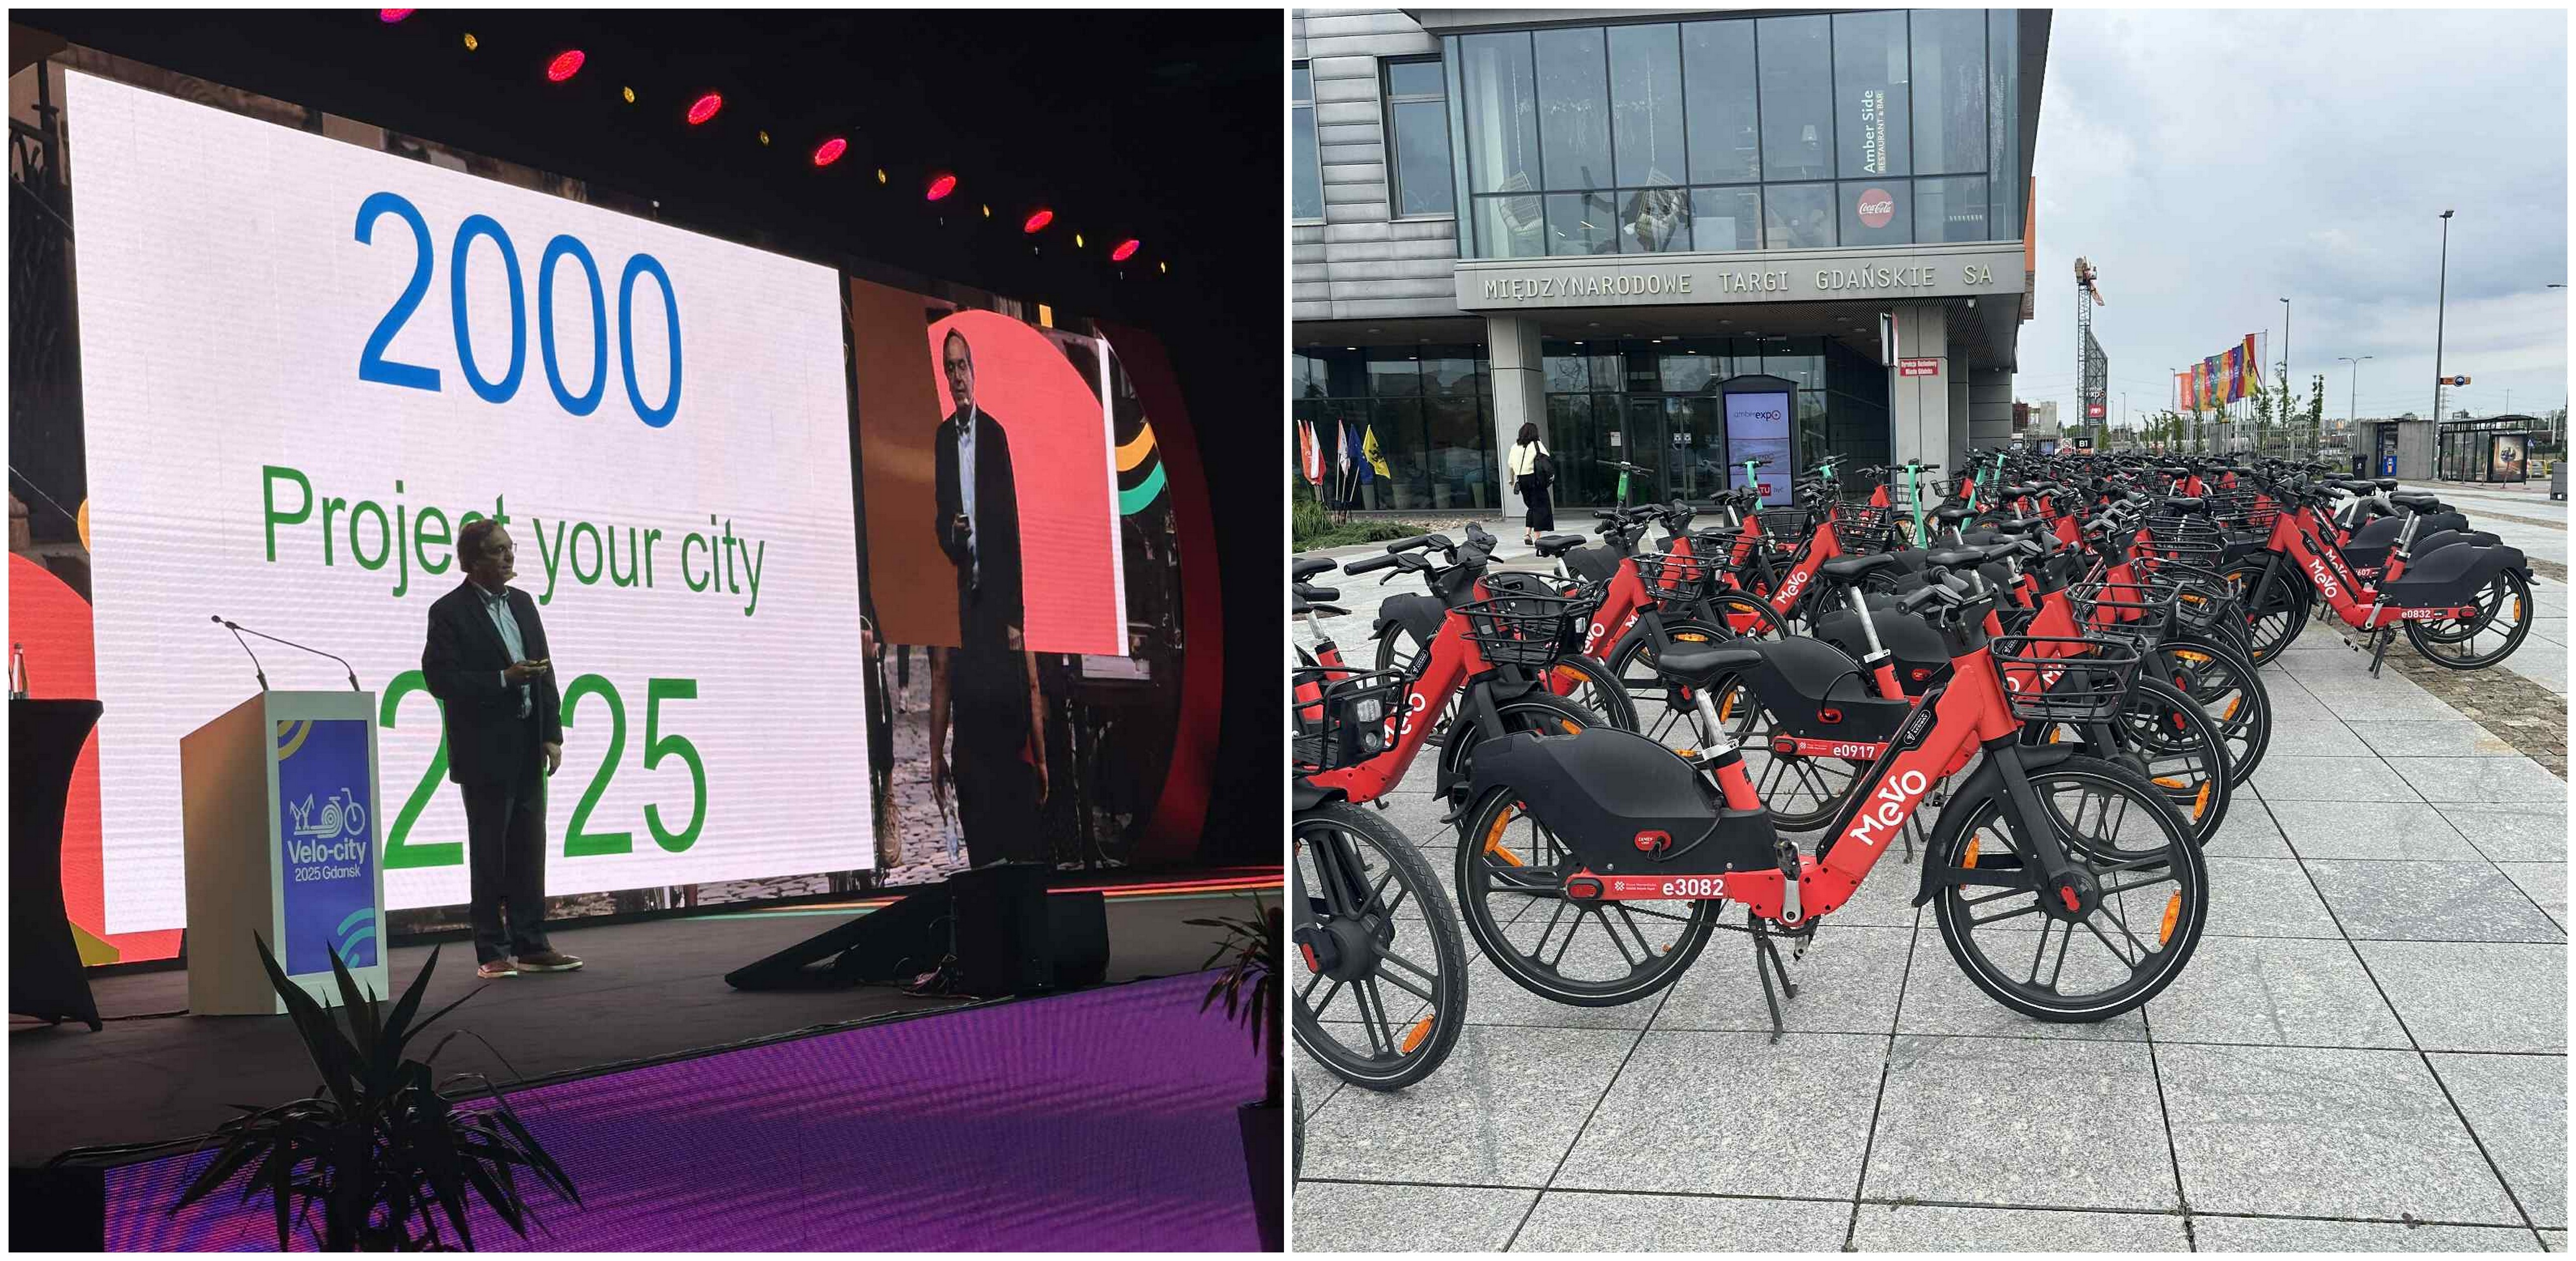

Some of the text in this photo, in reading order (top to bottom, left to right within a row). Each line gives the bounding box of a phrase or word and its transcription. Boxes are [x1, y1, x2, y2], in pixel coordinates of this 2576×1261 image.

[1862, 90, 1875, 173] Amber Side
[1877, 119, 1885, 172] RESTAURANT
[1484, 263, 1993, 301] MIĘDZYNARODOWE TARGI GDAŃSKIE SA
[355, 192, 682, 428] 2000
[262, 465, 765, 617] Proje your city
[2401, 610, 2431, 618] e0832
[379, 670, 707, 870] 225
[1833, 744, 1875, 758] e0917
[287, 837, 366, 864] Velo-city
[295, 866, 321, 882] 2025
[1663, 879, 1724, 896] e3082
